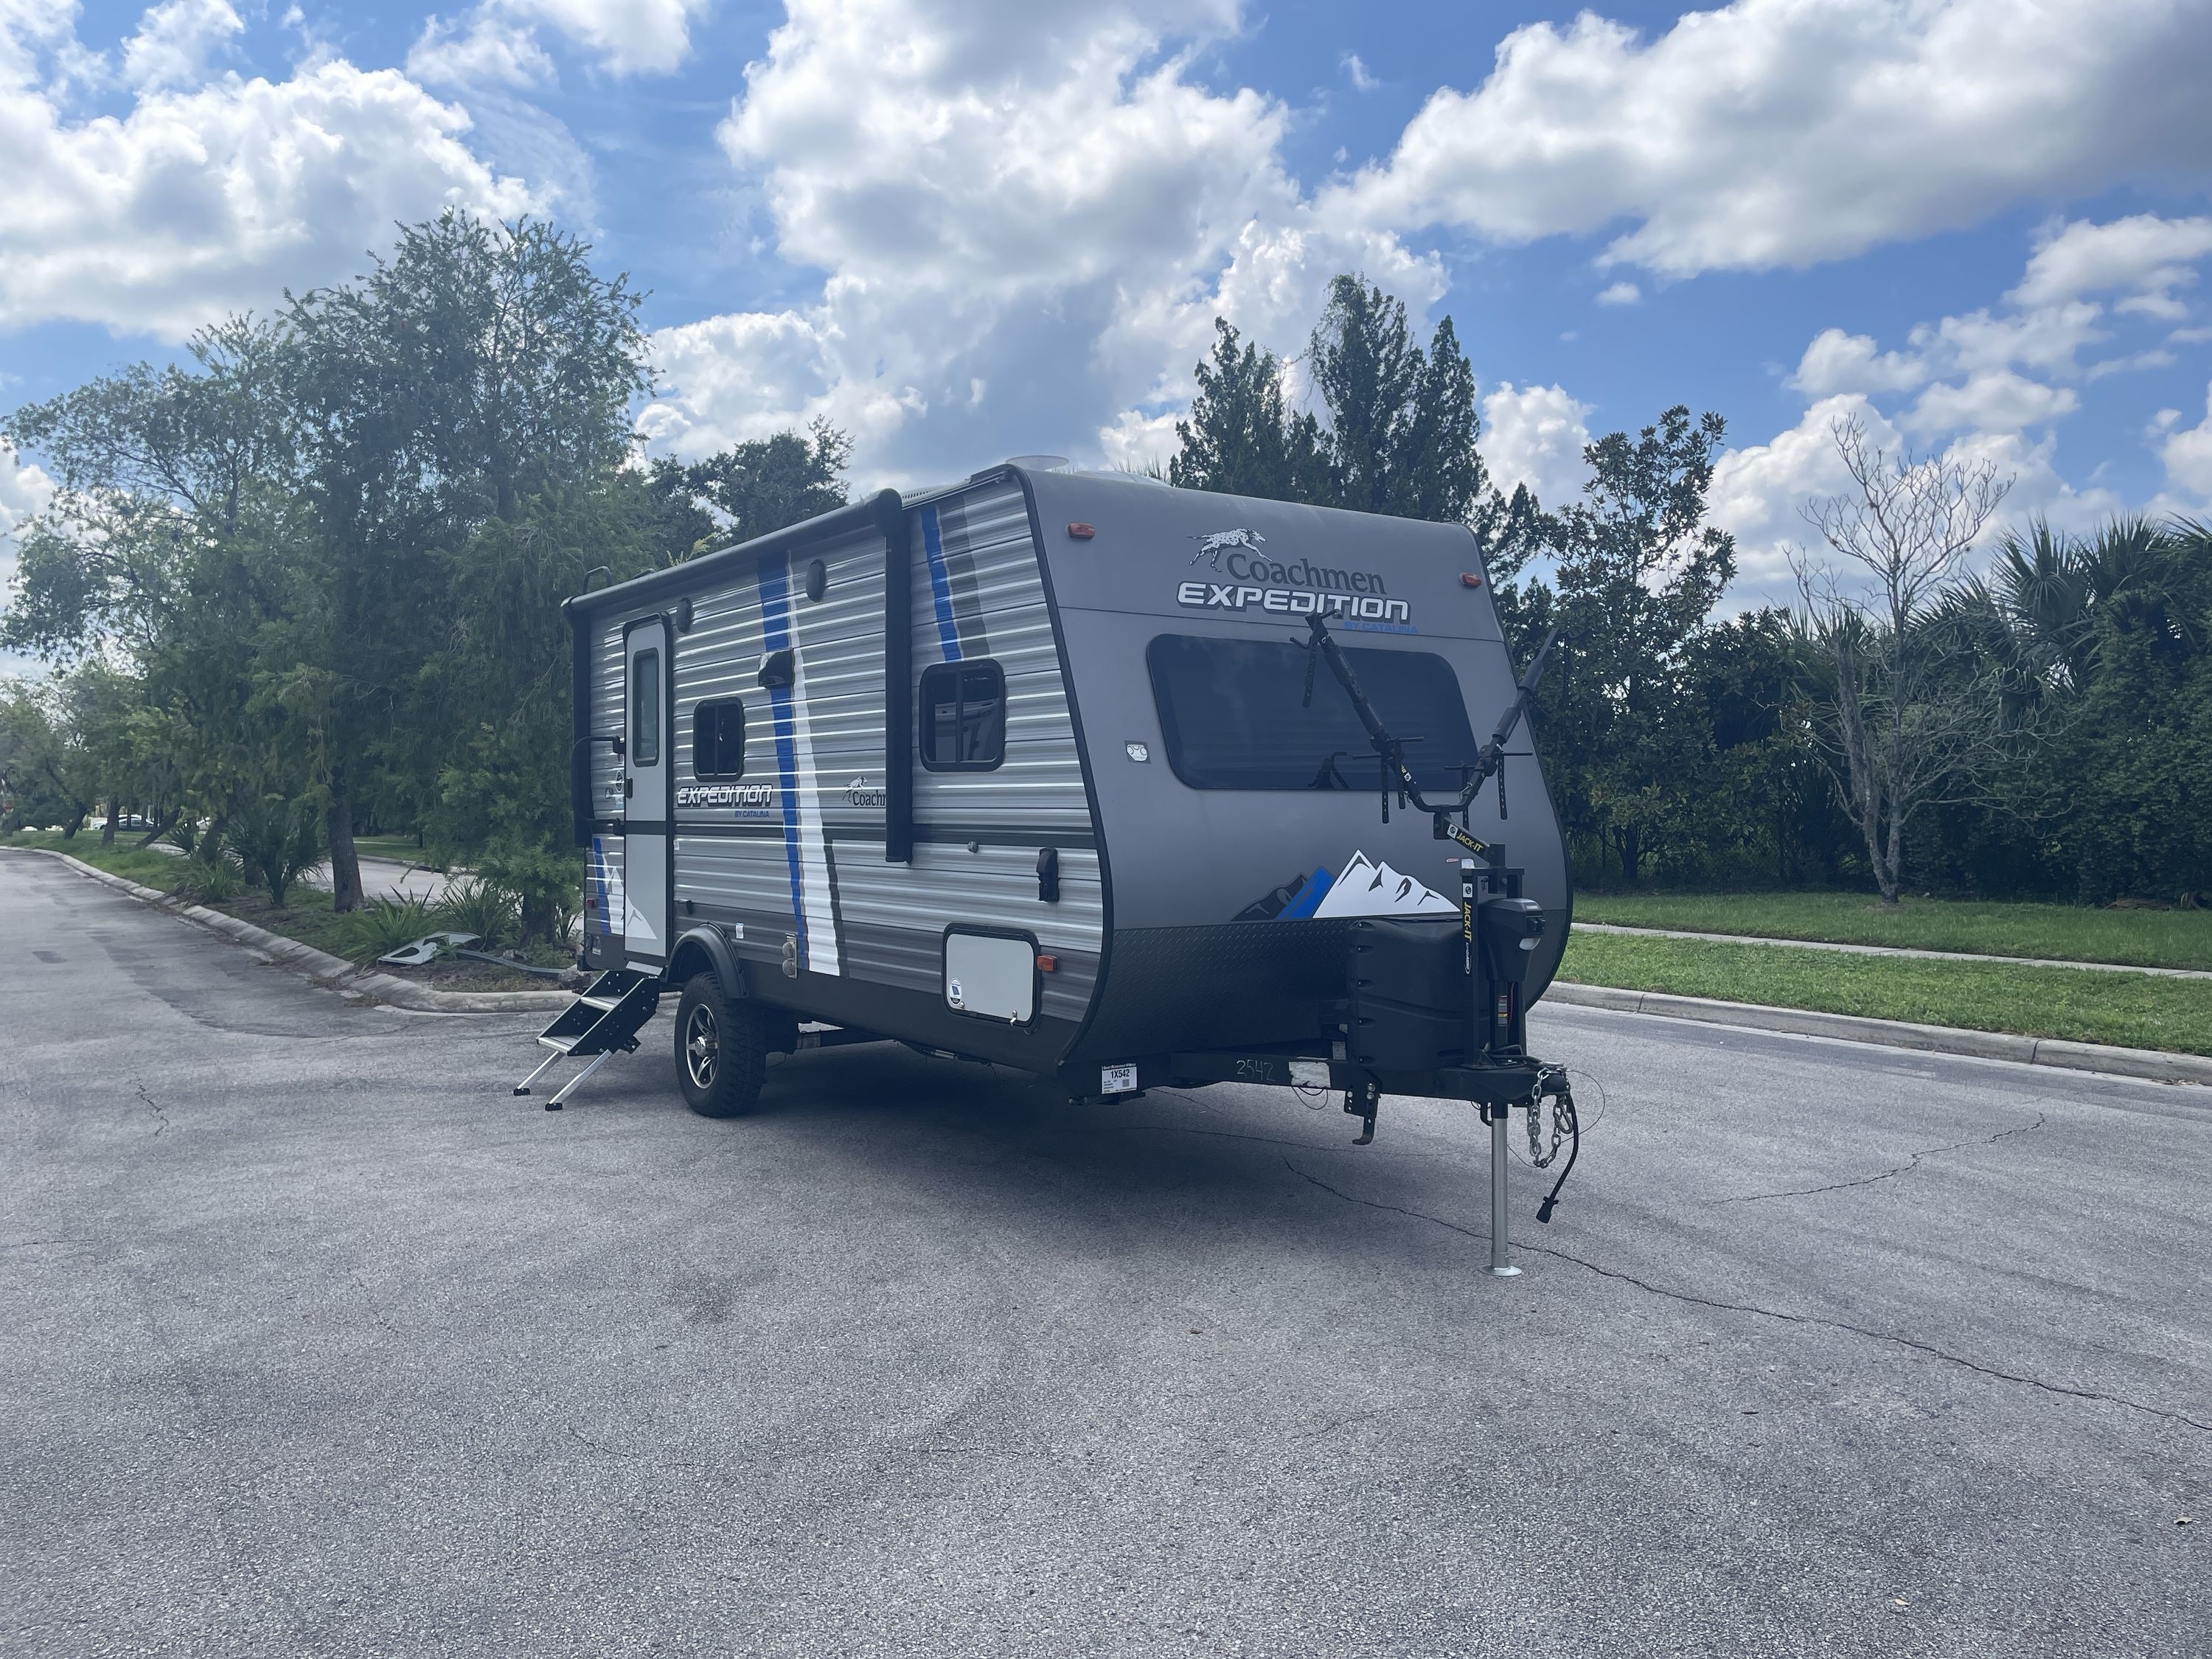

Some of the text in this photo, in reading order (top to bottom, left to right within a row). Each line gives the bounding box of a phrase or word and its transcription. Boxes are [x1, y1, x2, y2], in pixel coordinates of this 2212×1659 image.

[1227, 553, 1387, 594] Coachmen
[1178, 580, 1410, 623] EXPEDITION
[1344, 622, 1419, 634] BY CATALINA
[677, 785, 773, 807] EXPEDITION
[1456, 832, 1484, 852] JACK-IT
[1464, 902, 1472, 943] JACK-IT
[1110, 1068, 1130, 1079] 1X542
[1237, 1060, 1276, 1082] 2542
